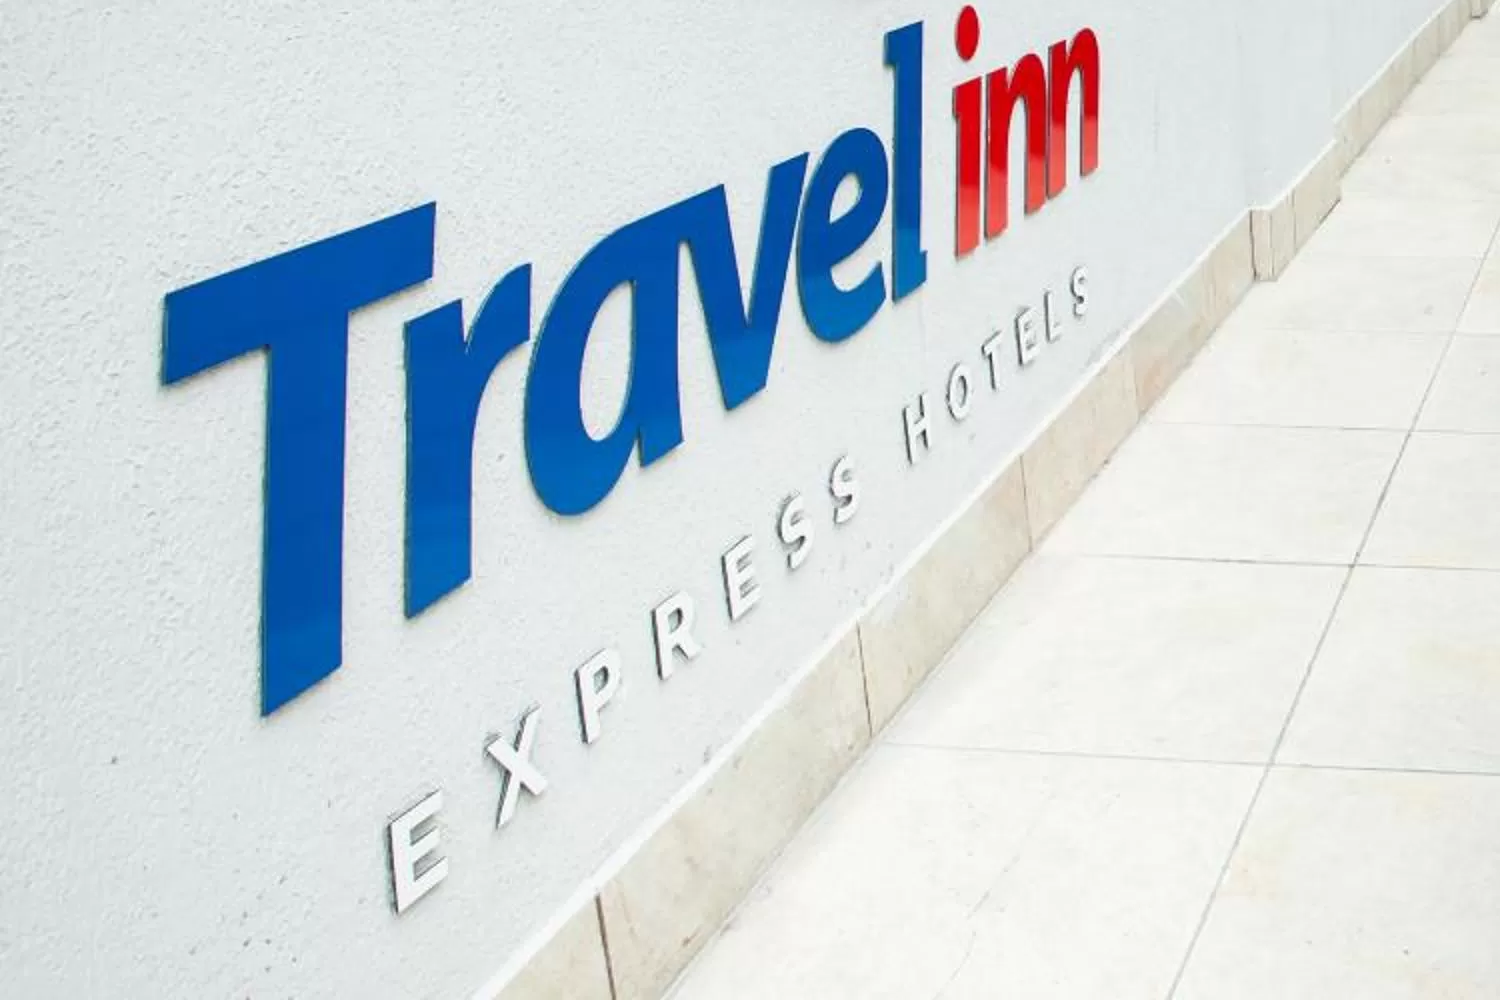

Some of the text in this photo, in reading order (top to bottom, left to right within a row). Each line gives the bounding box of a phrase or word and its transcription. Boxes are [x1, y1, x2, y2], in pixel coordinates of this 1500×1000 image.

[161, 4, 1100, 718] Travel inn
[387, 264, 1089, 915] EXPRESS HOTELS
